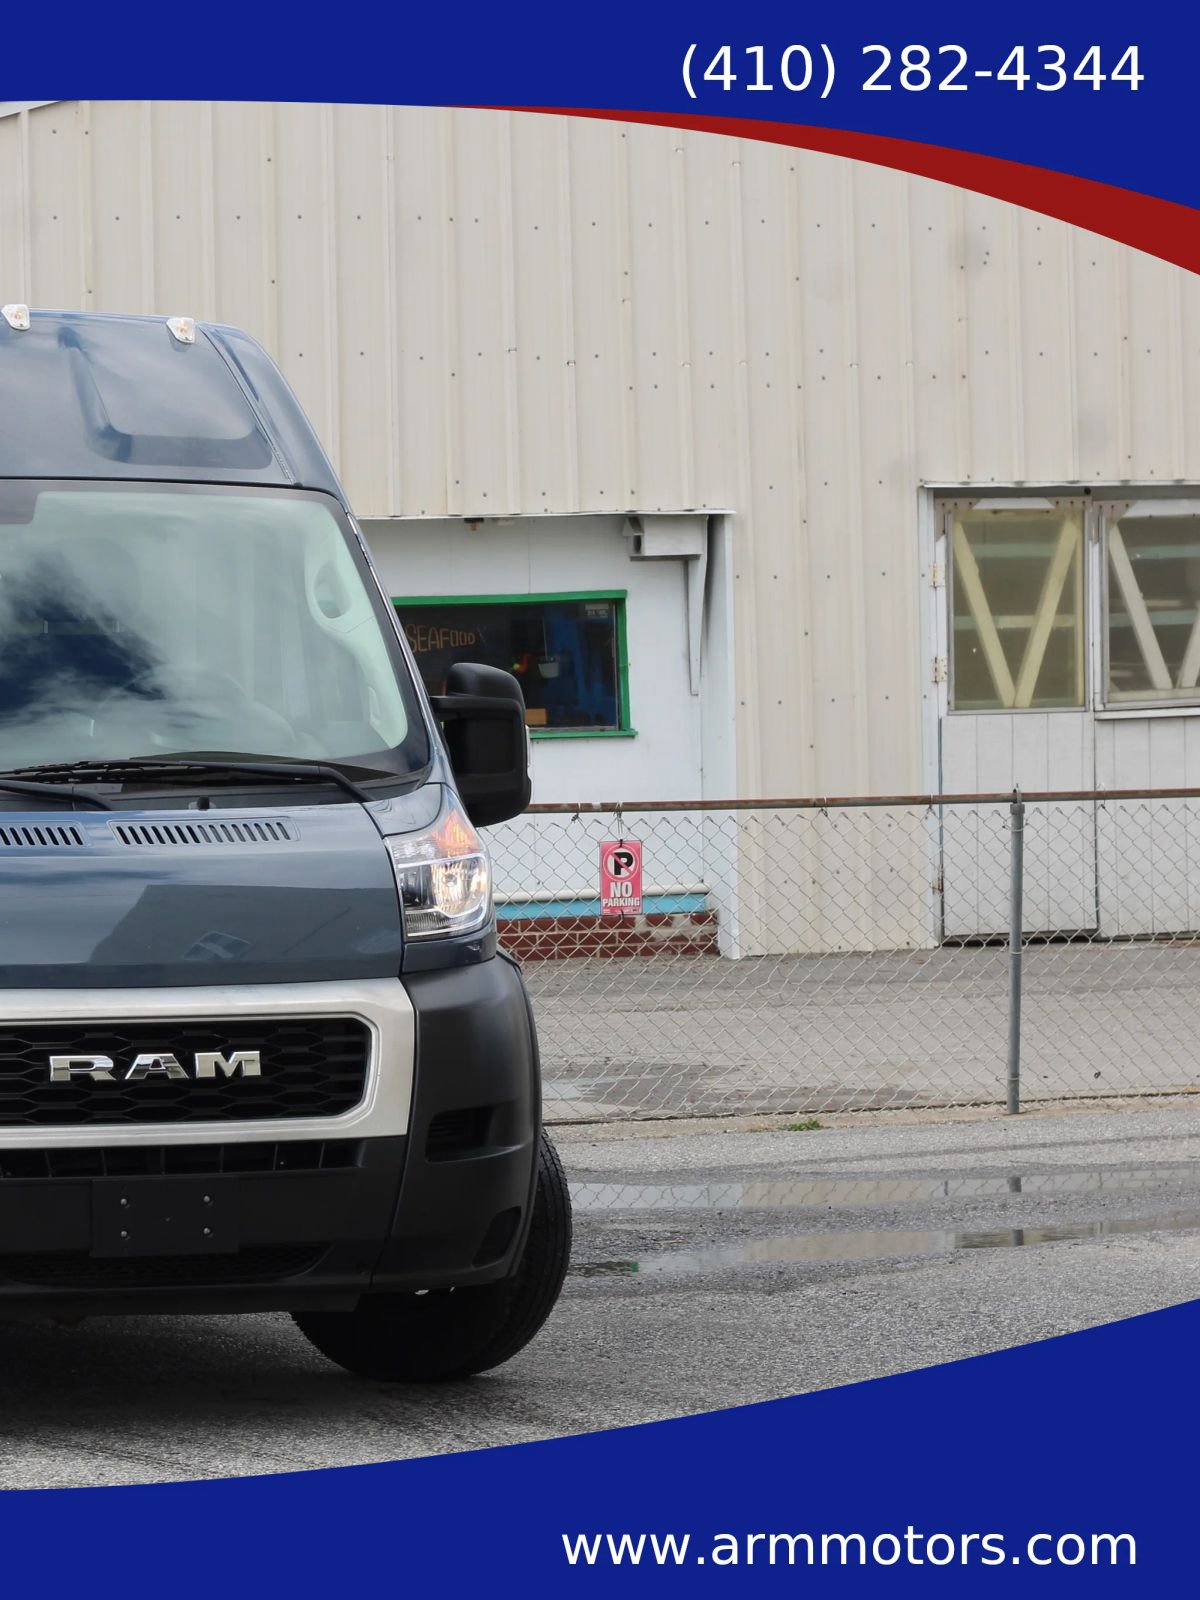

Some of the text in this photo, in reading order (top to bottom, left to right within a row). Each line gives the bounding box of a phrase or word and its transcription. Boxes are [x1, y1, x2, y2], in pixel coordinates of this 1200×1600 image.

[404, 623, 477, 653] SEAFOOD
[609, 881, 633, 898] NO
[602, 897, 641, 907] PARKING
[48, 1050, 262, 1083] RAM
